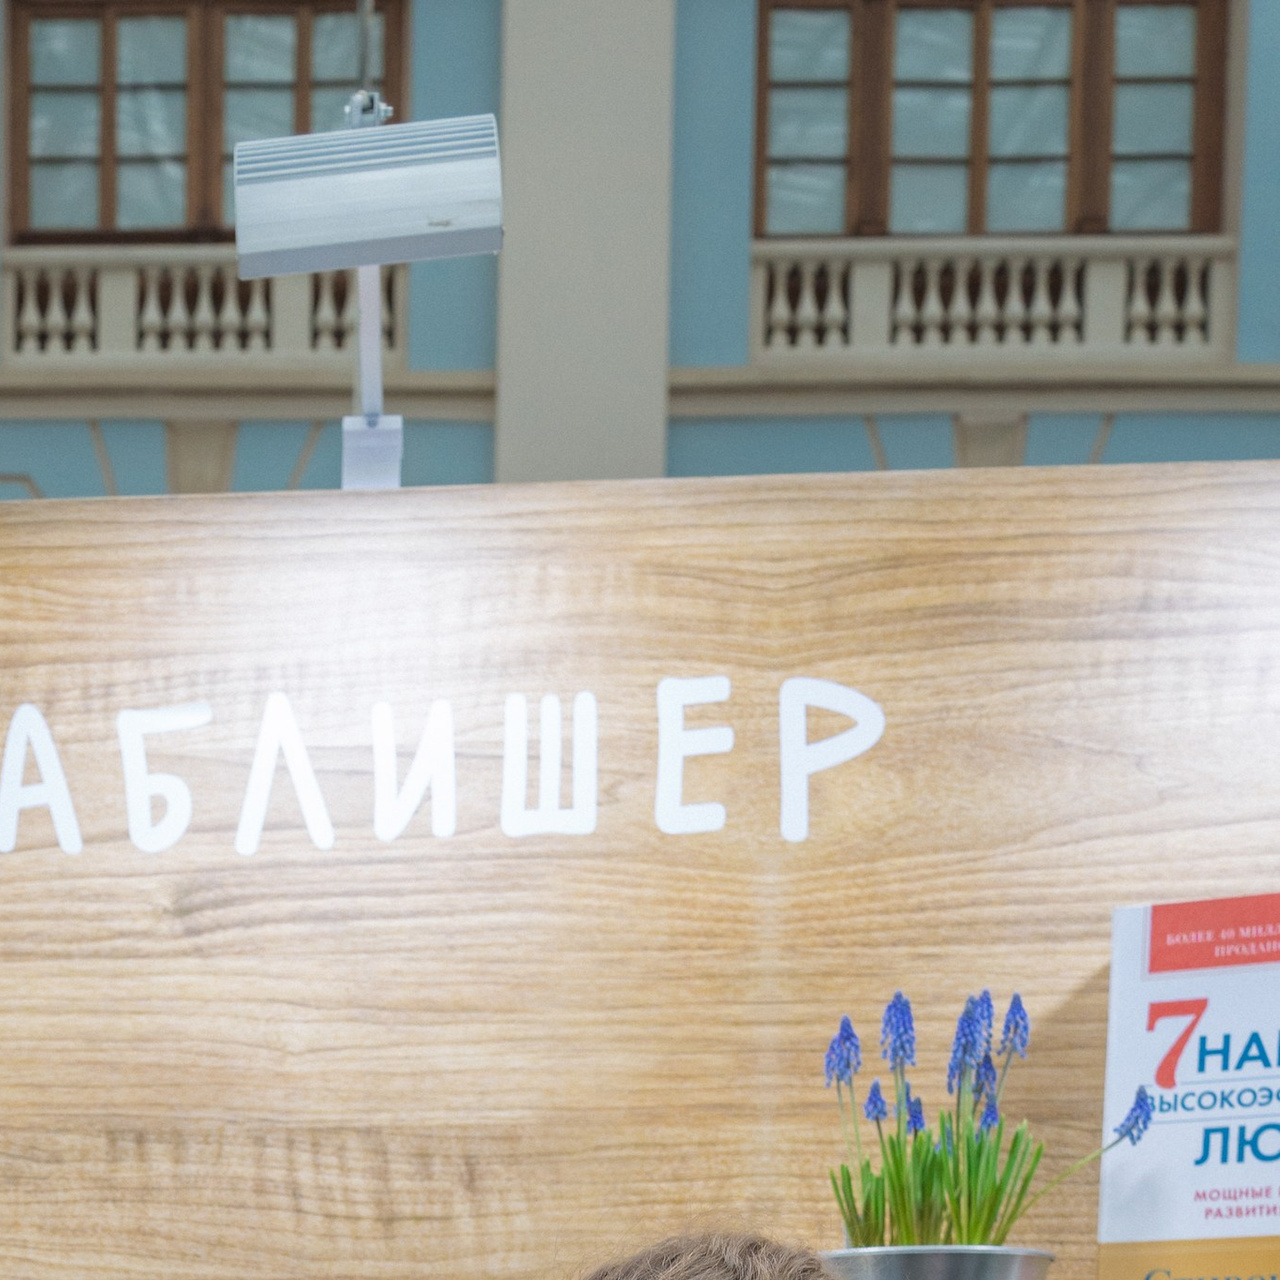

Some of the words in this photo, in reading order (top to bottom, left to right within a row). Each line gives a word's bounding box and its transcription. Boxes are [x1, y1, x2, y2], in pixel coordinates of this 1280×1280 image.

[1146, 998, 1209, 1089] 7
[1197, 1030, 1280, 1073] НА
[1194, 1185, 1272, 1203] МОЩНЫЕ
[1205, 1204, 1280, 1220] РАЗВИТИ
